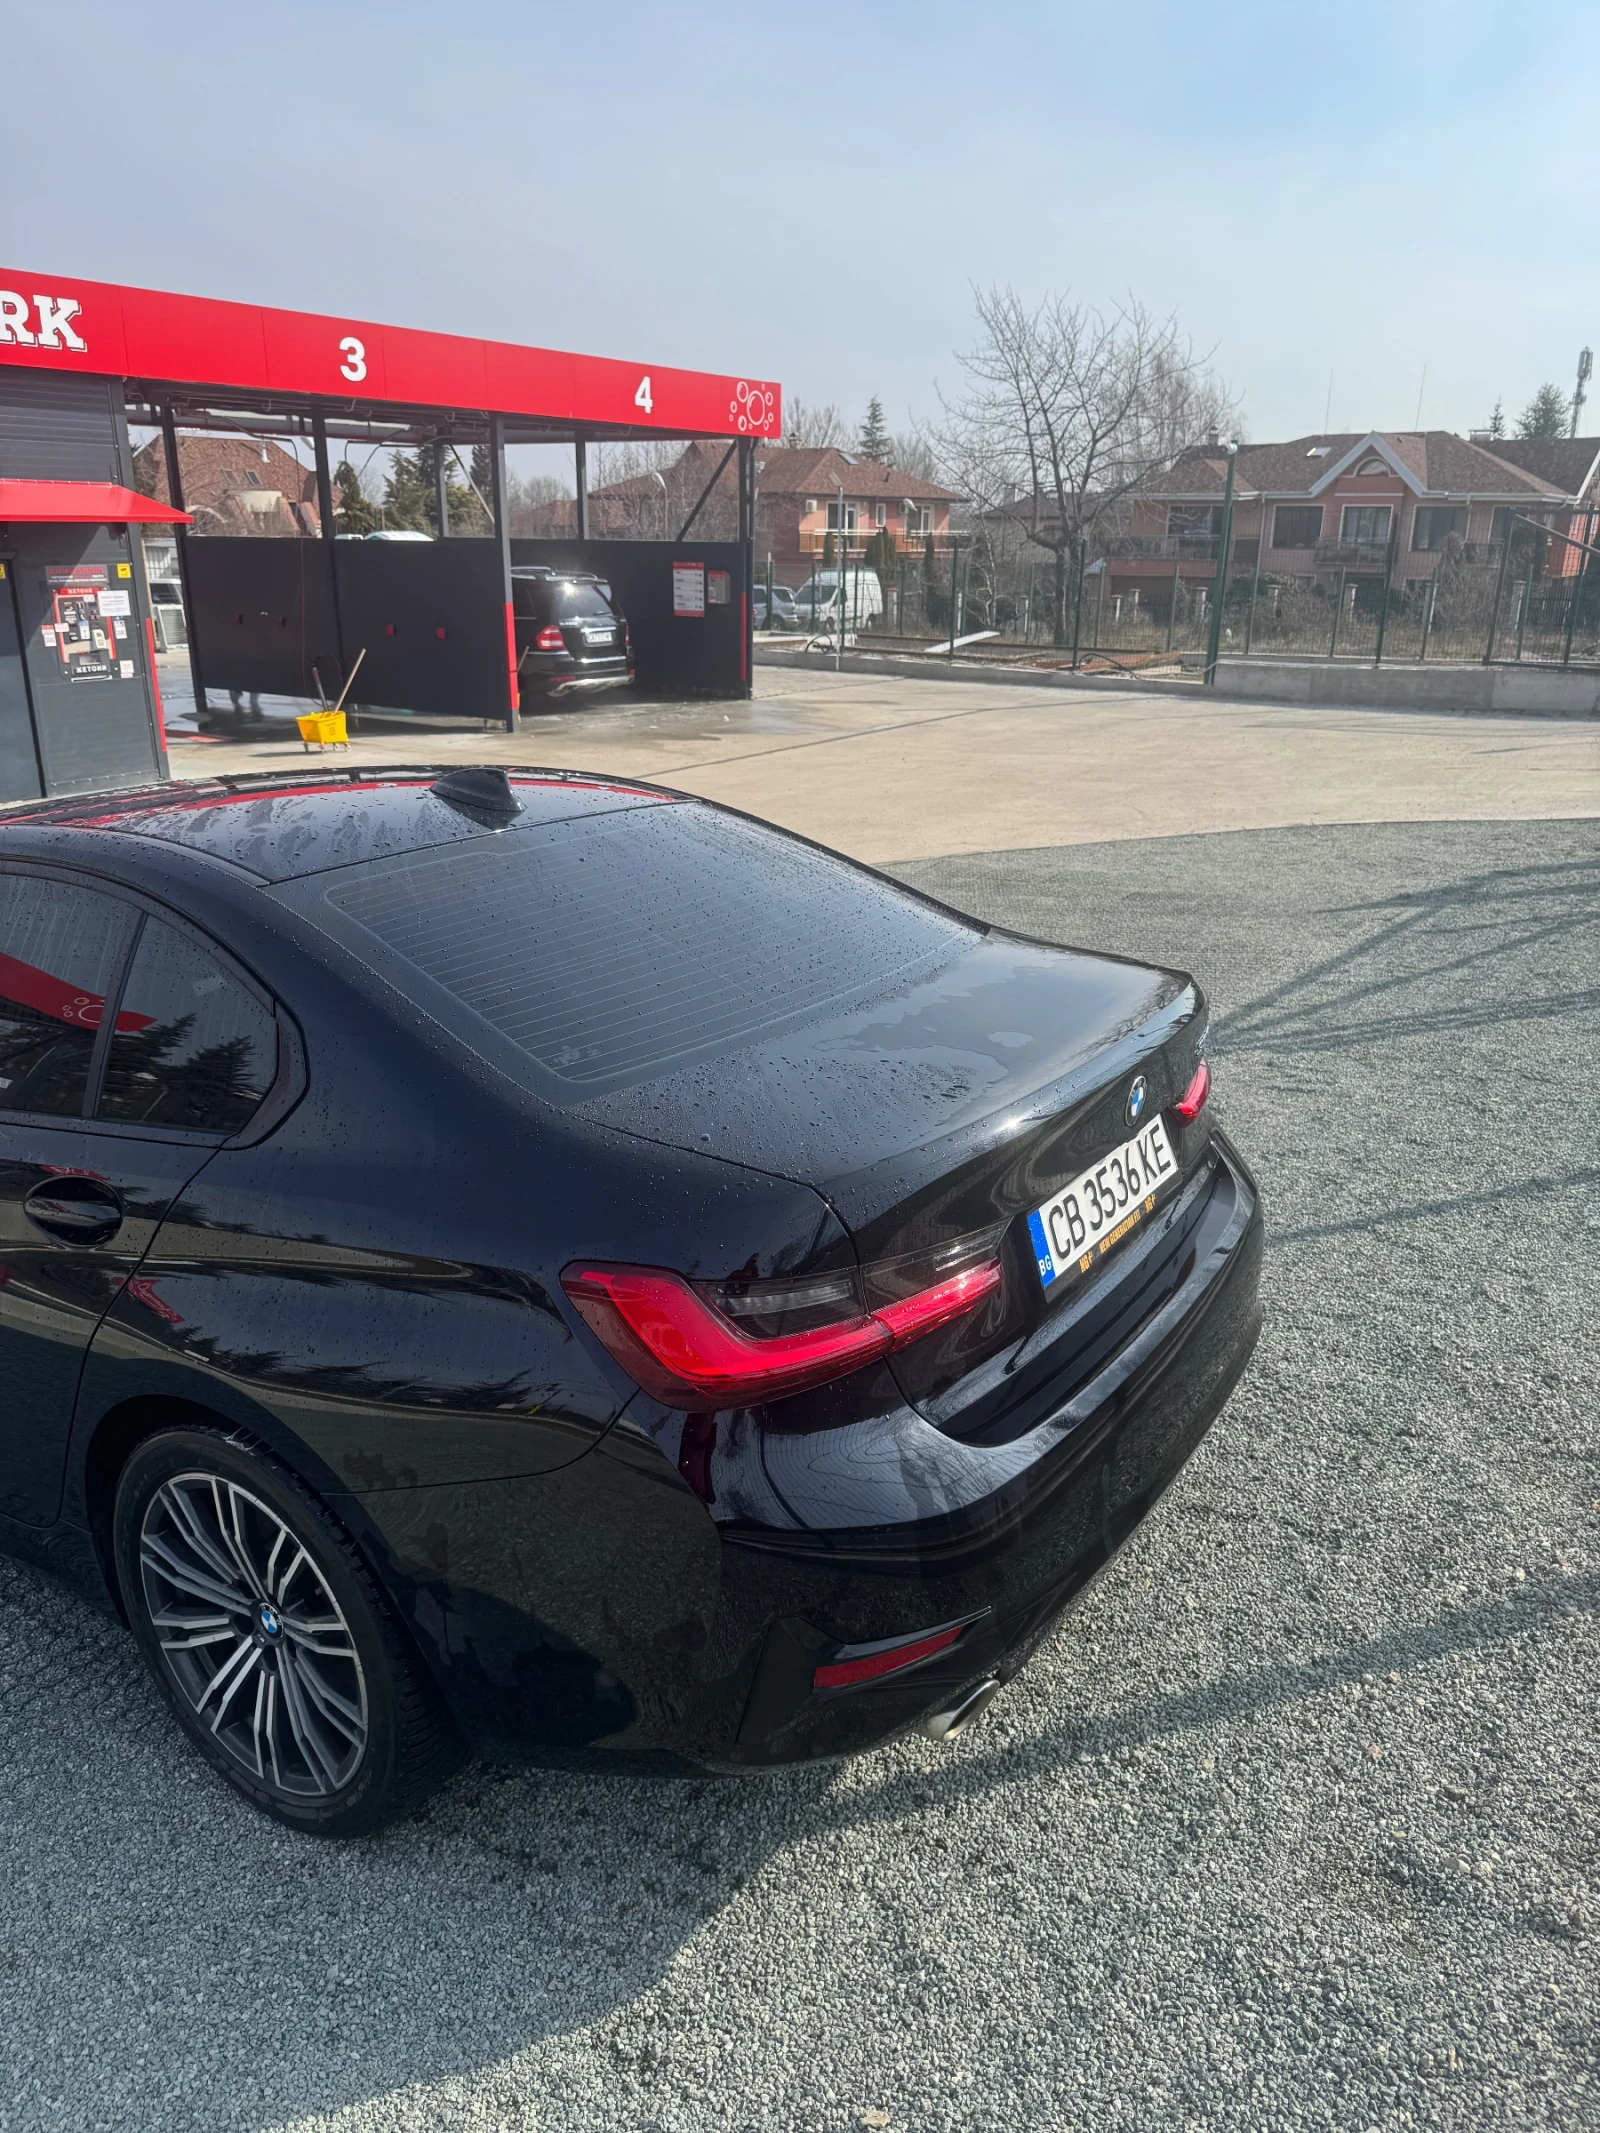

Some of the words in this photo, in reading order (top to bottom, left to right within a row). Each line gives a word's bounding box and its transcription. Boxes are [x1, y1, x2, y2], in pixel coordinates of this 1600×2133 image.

[339, 336, 367, 382] 3
[634, 376, 653, 414] 4
[75, 665, 108, 674] ЖЕТОНИ
[1048, 1193, 1086, 1261] CB
[1083, 1147, 1141, 1231] 3536
[1137, 1123, 1171, 1186] KE
[1039, 1254, 1052, 1276] BG
